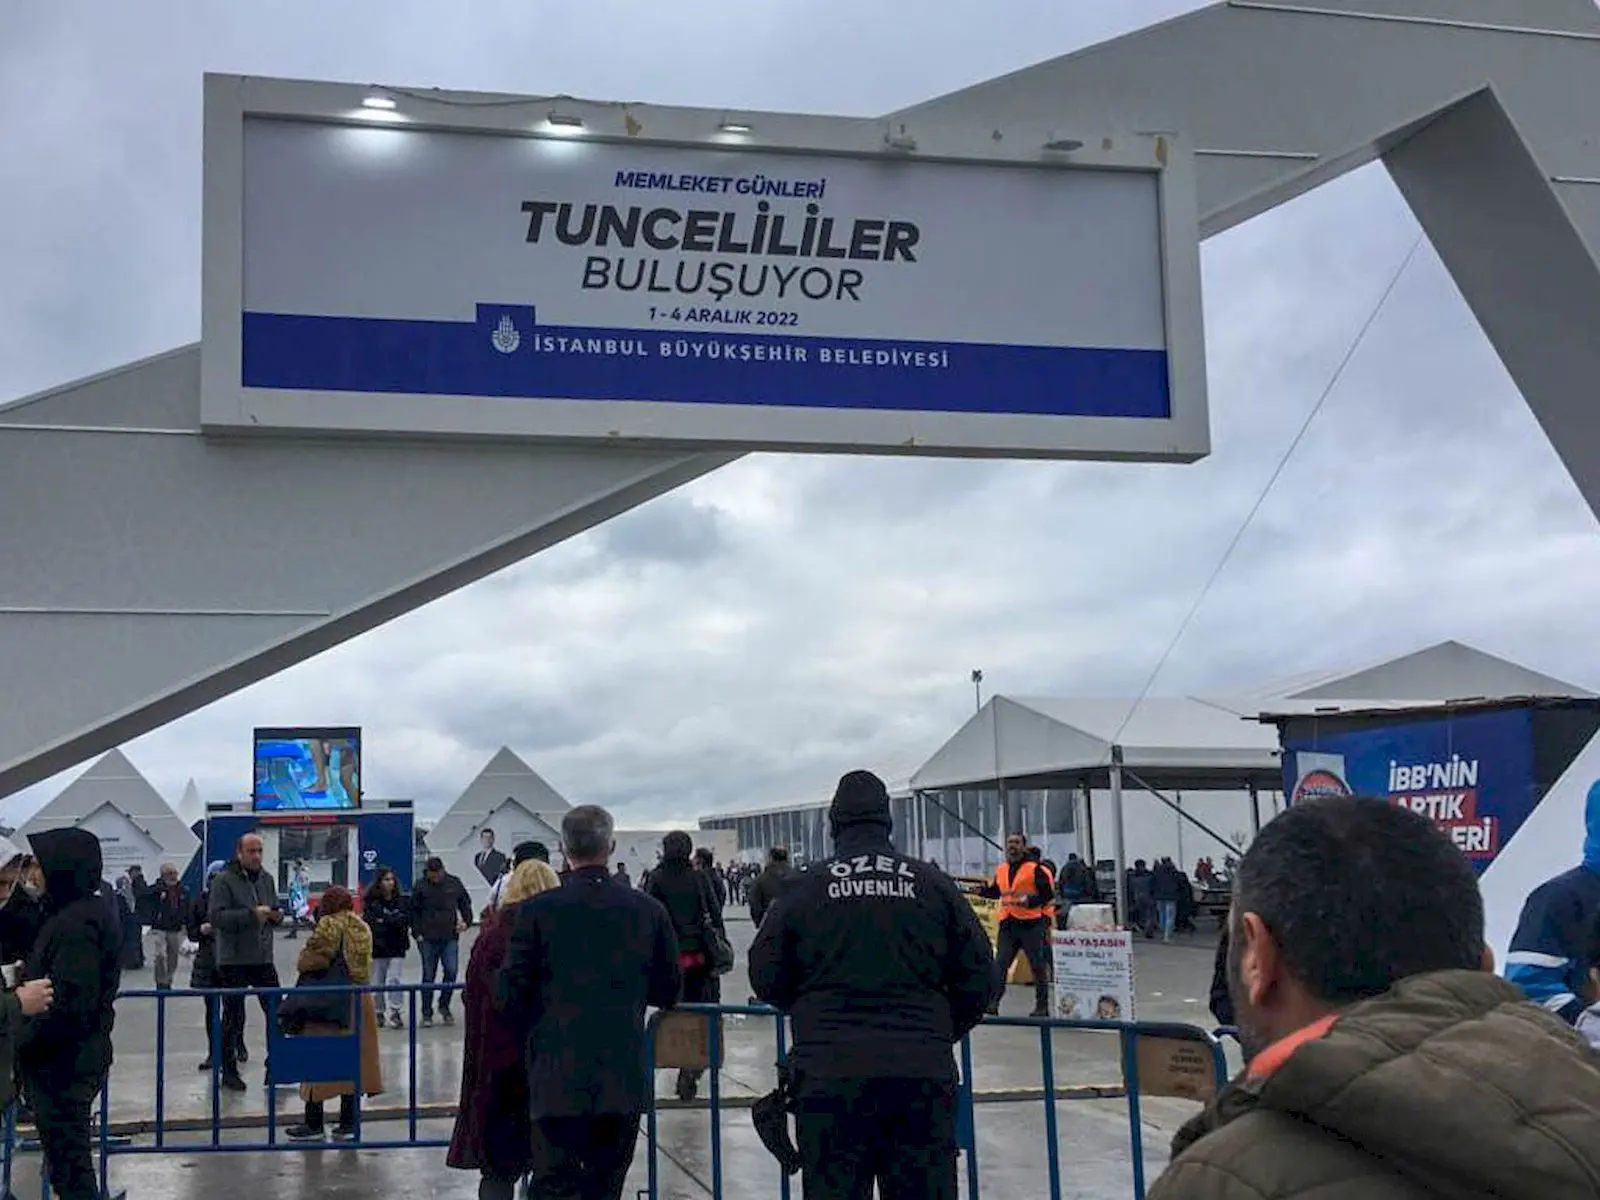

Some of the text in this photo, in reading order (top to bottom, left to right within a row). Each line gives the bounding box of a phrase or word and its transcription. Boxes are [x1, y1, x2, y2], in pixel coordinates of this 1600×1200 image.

[613, 171, 826, 199] MEMLEKET GÜNLERİ
[520, 200, 920, 263] TUNCELİLİLER
[581, 255, 864, 302] BULUŞUYOR
[684, 308, 752, 325] ARALIK
[756, 311, 799, 327] 2022
[534, 333, 950, 368] İSTANBUL BÜYÜKŞEHİR BELEDİYESİ
[1388, 754, 1478, 792] İBB'NİN
[827, 855, 915, 878] ÖZEL
[827, 877, 917, 899] GÜVENLİK
